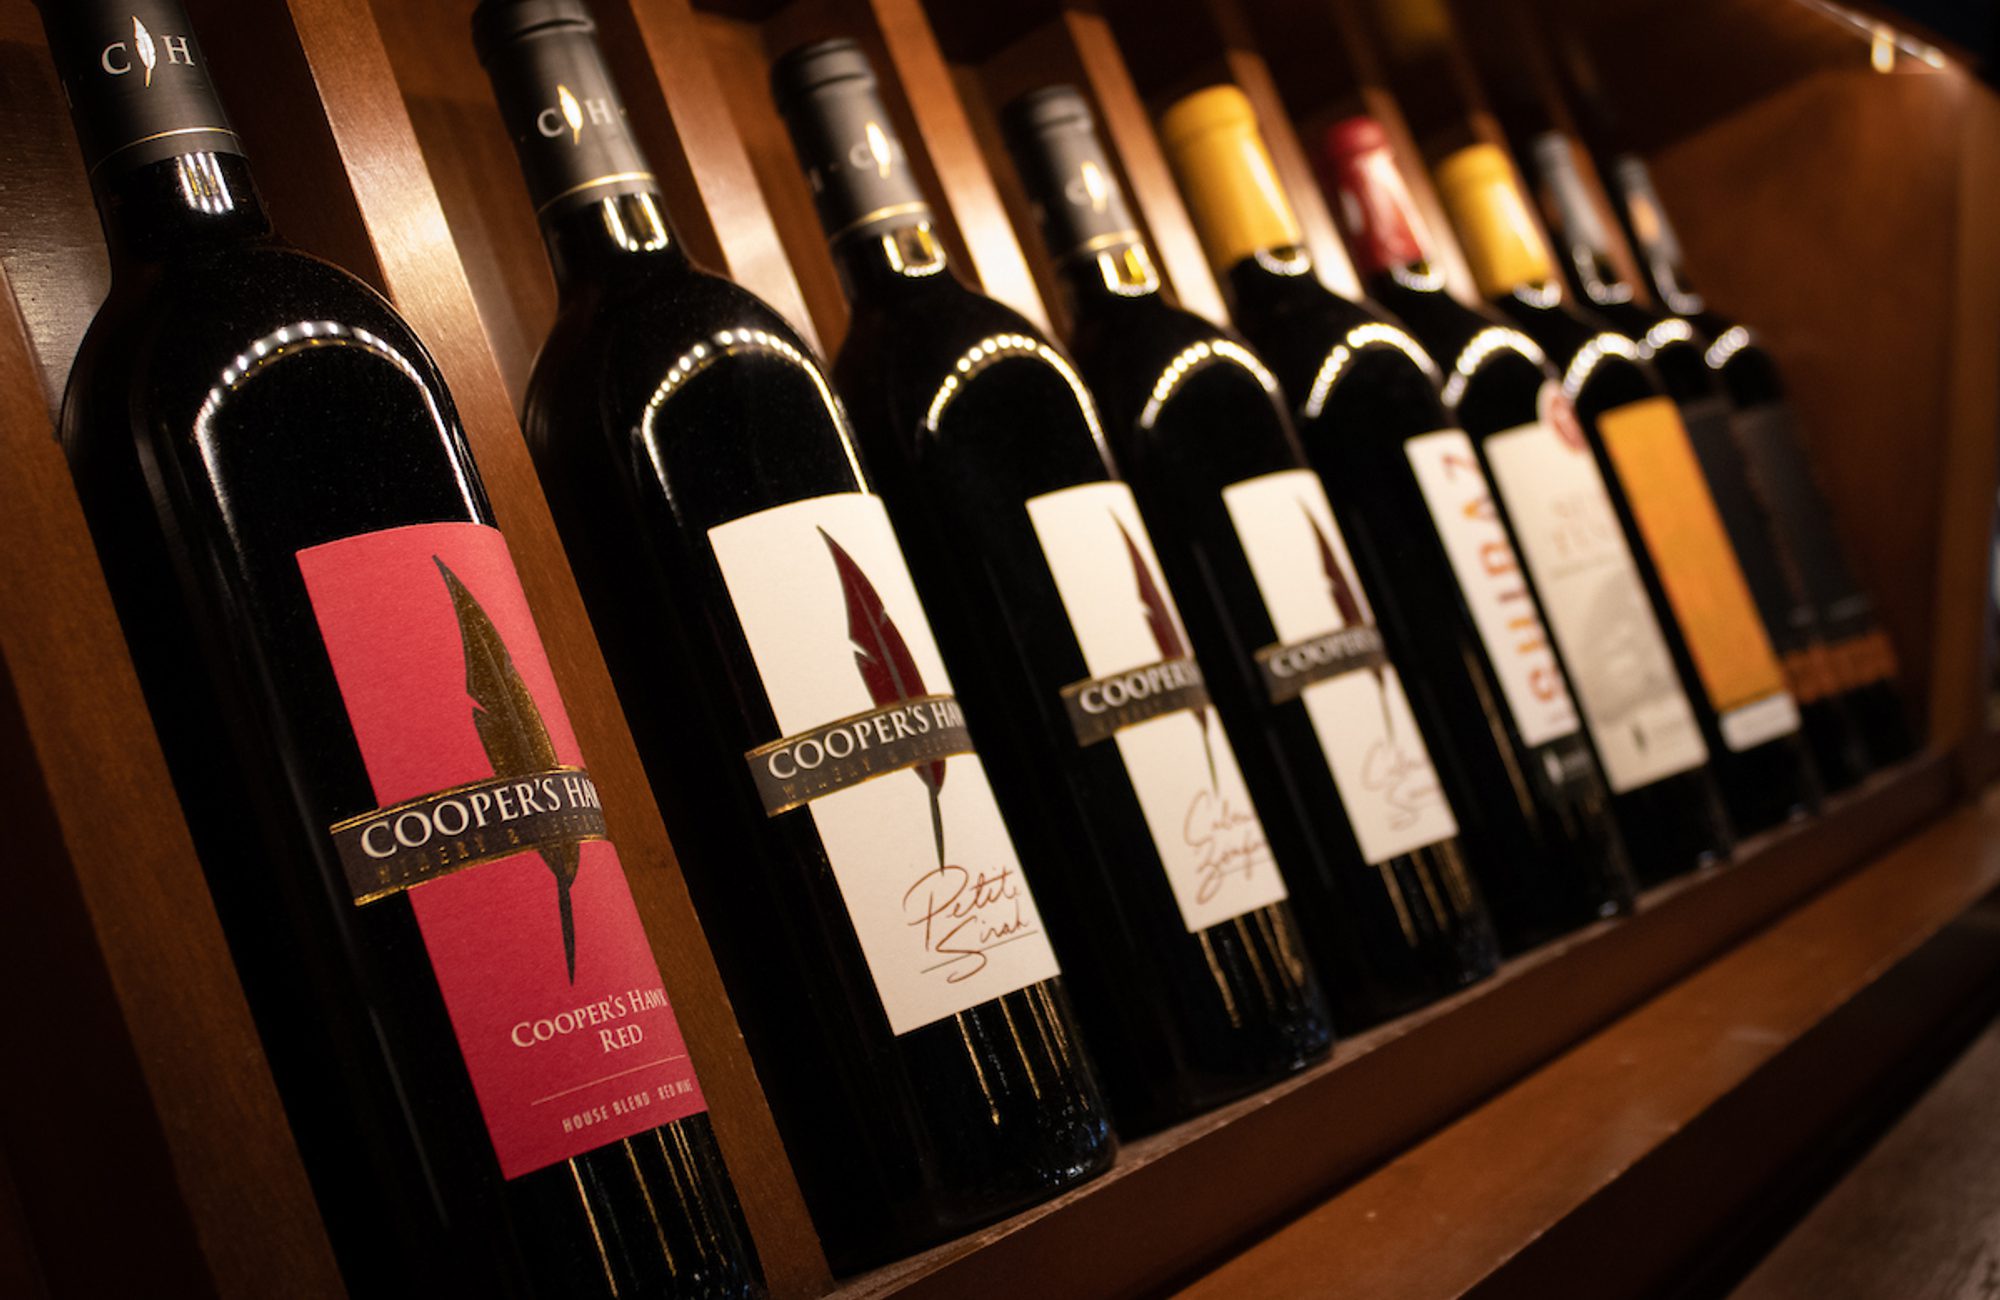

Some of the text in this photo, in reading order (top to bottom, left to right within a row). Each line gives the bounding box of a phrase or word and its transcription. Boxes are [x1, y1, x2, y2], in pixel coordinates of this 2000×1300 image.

[101, 34, 196, 75] C H
[537, 98, 613, 138] C H
[767, 705, 930, 780] COOPER'S
[360, 776, 562, 860] COOPER'S
[511, 995, 627, 1048] COOPER'S
[599, 1024, 643, 1053] RED
[562, 1105, 609, 1133] HOUSE
[612, 1091, 651, 1116] BLEND
